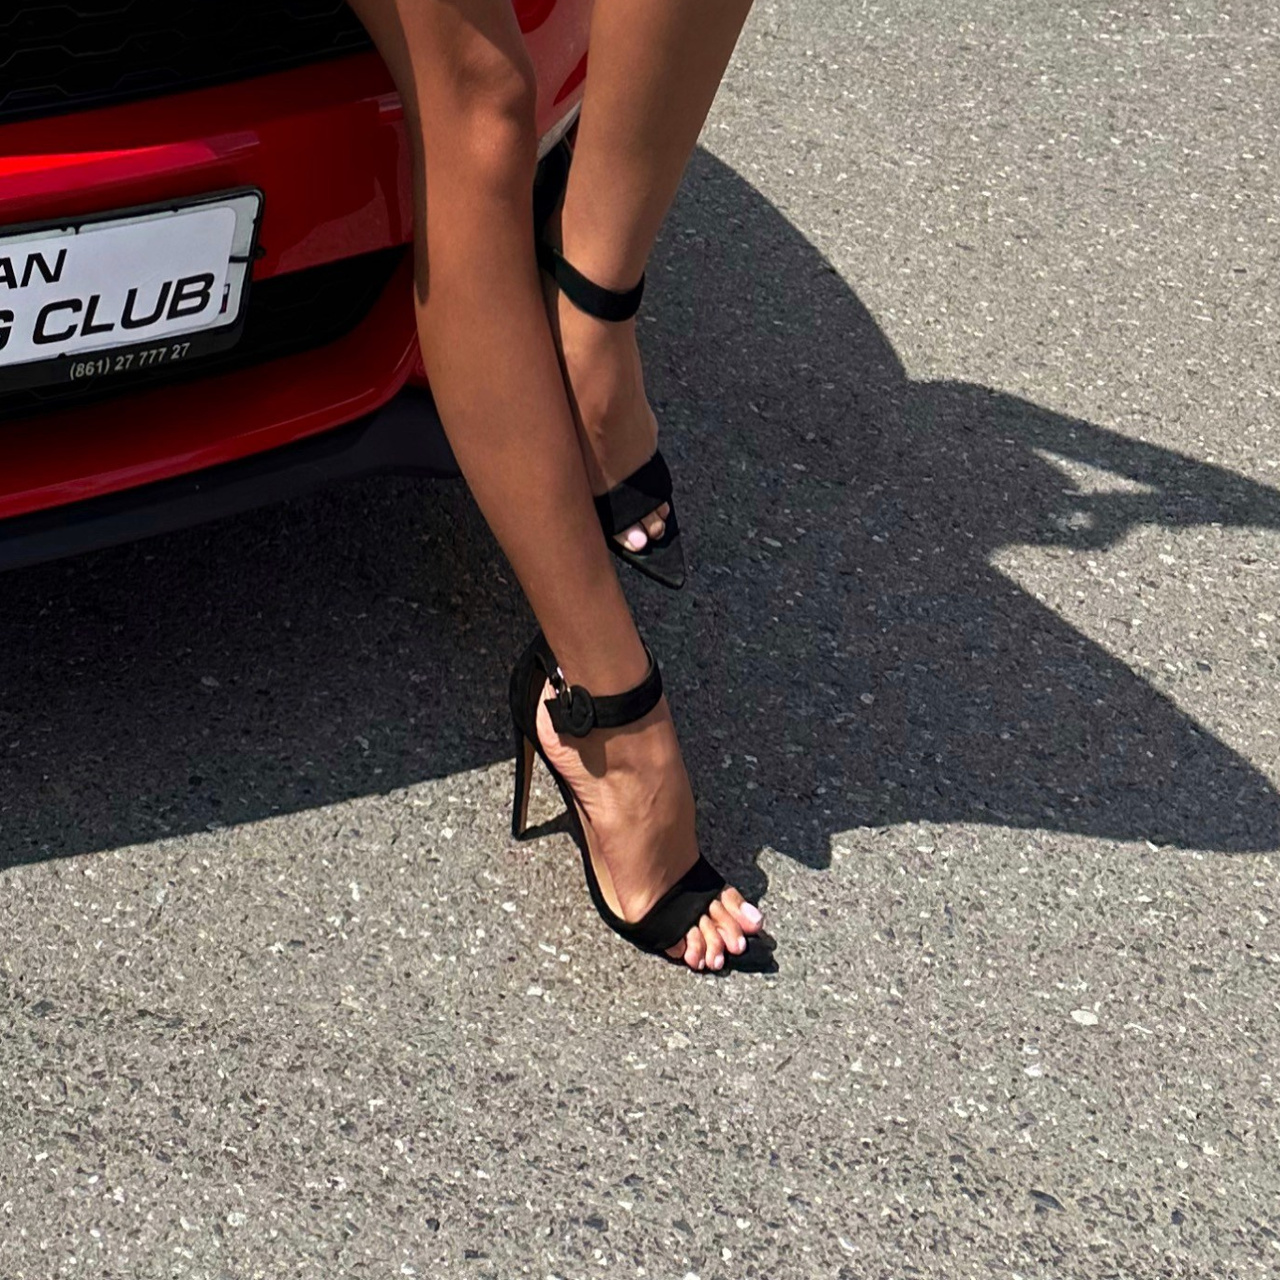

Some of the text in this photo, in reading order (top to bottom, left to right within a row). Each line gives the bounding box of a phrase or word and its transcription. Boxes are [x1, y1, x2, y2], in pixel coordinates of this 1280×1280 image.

[32, 272, 215, 345] CLUB
[70, 343, 191, 380] (861) 27 777 27
